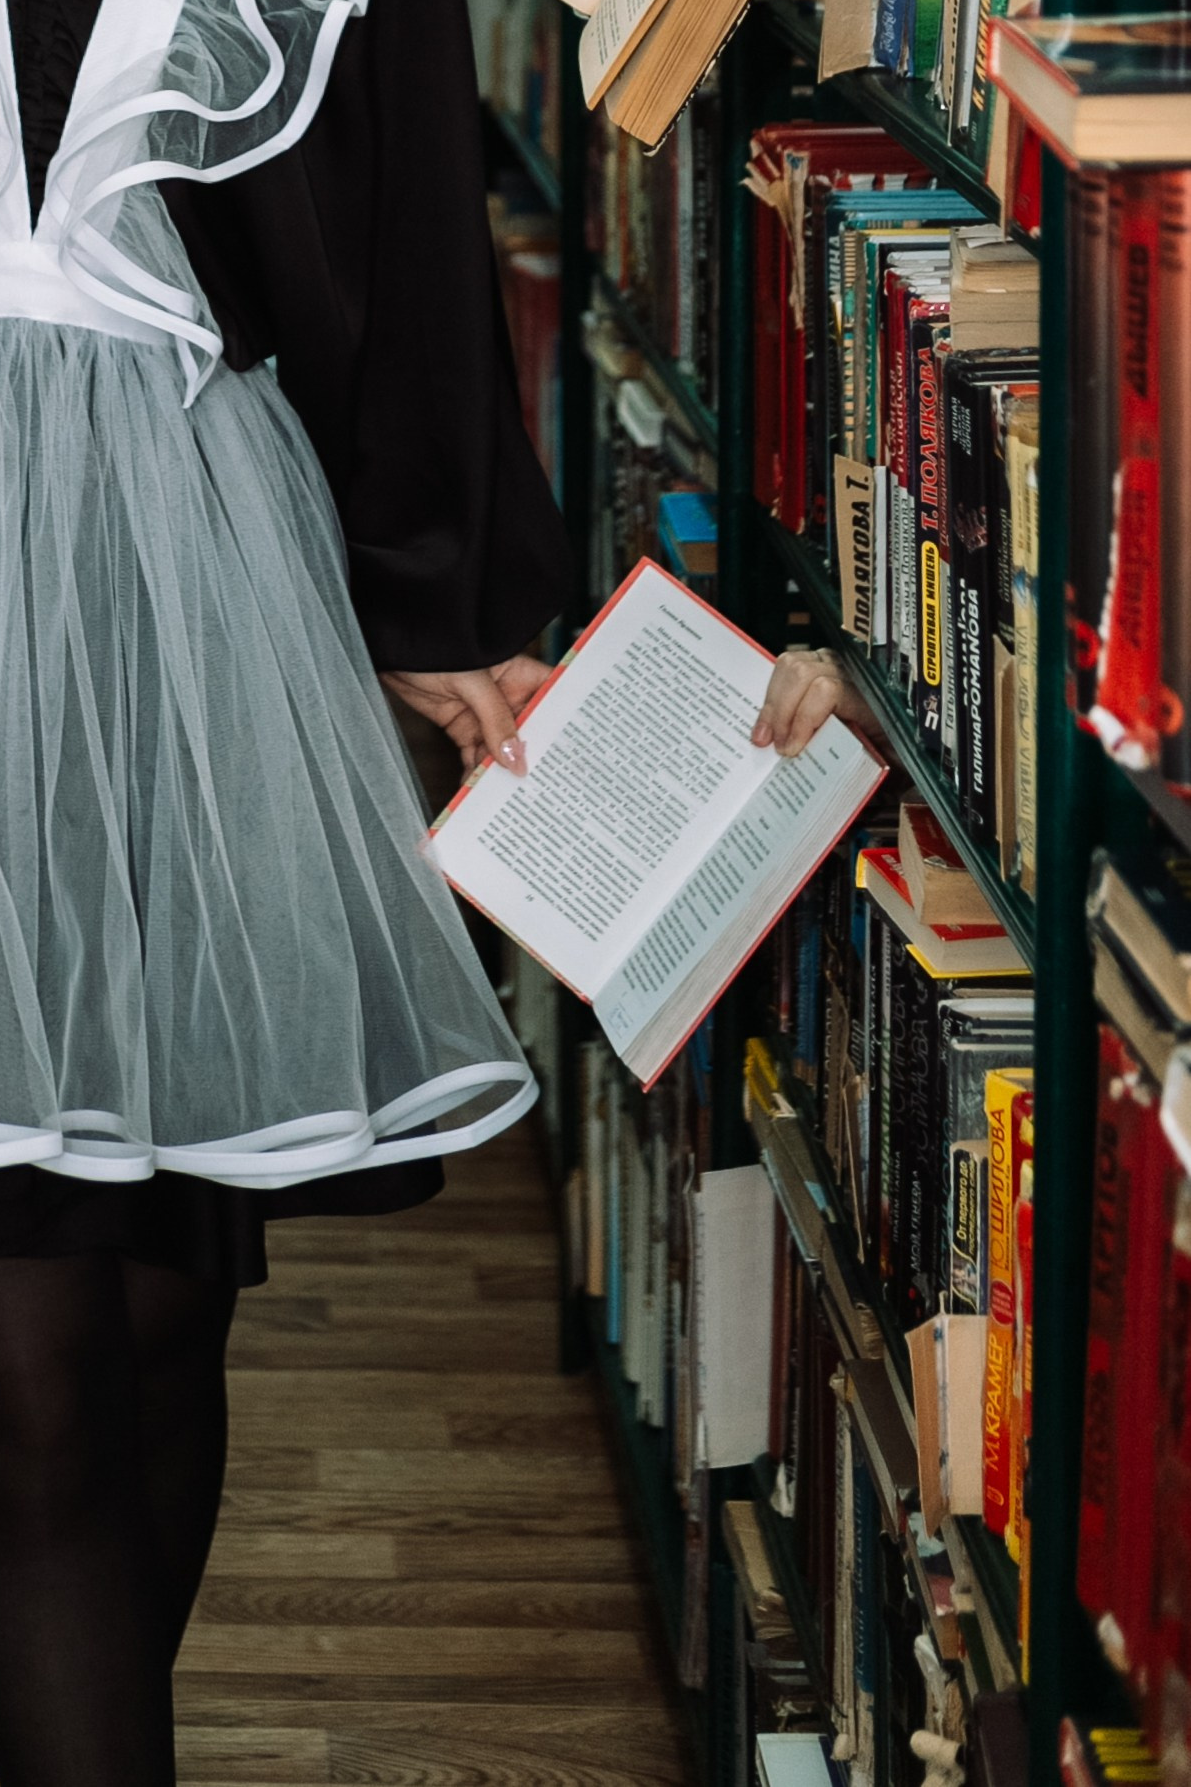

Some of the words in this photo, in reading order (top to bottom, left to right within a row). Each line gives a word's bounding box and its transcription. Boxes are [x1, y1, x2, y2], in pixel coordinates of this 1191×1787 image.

[917, 346, 938, 507] ПОЛЯКОВА
[951, 396, 959, 442] ЧЕРНАЯ
[846, 474, 870, 492] Т.
[892, 482, 900, 560] Полякова
[901, 496, 910, 575] Полякова
[921, 510, 938, 531] Т.
[851, 500, 871, 637] ПОЛЯКОВА
[924, 546, 935, 600] МИШЕНЬ
[925, 604, 937, 681] СТРОПТИВАЯ
[945, 665, 955, 731] Татьяна
[972, 720, 984, 795] ГАЛИНА
[958, 1176, 968, 1224] первого
[959, 1160, 967, 1176] до
[990, 1108, 1005, 1234] ШИЛОВА
[910, 1233, 921, 1272] МОЙ
[957, 1225, 967, 1241] От
[985, 1333, 1003, 1439] КРАМЕР
